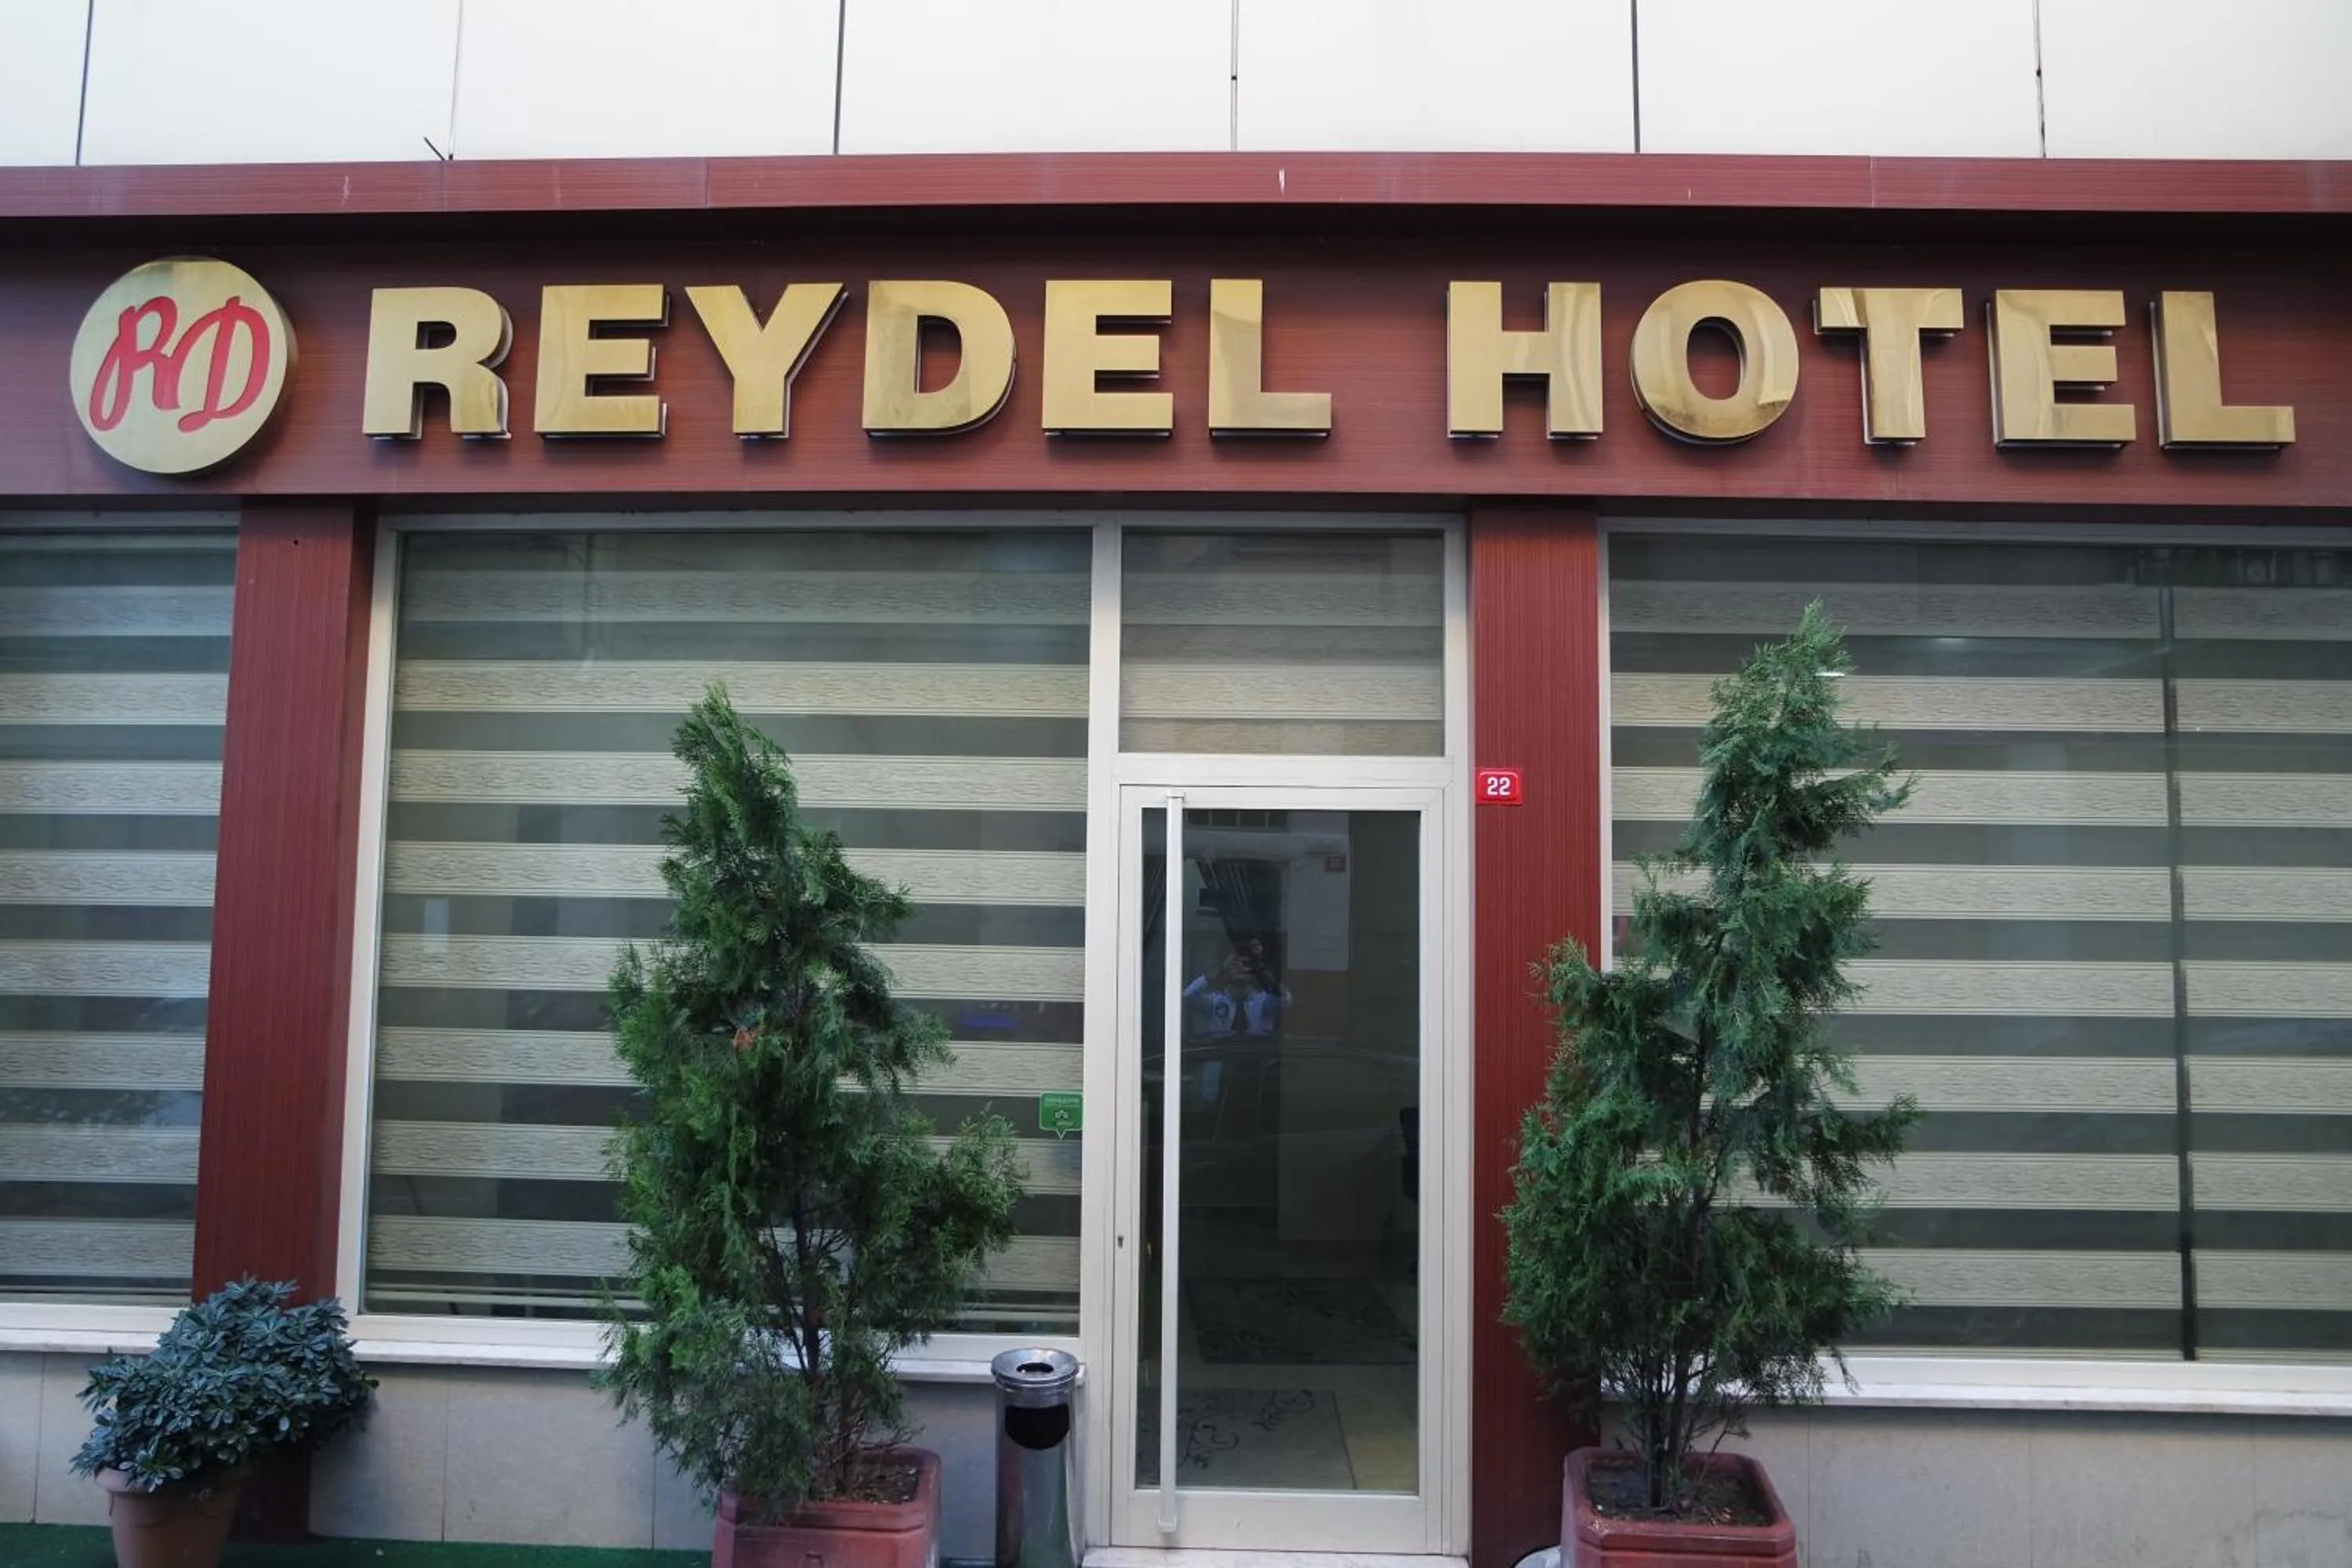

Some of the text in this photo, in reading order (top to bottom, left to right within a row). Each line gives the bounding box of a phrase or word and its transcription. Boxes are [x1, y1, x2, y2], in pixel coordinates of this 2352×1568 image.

[89, 295, 271, 433] RD
[362, 278, 2296, 448] REYDEL HOTEL
[1487, 776, 1511, 796] 22
